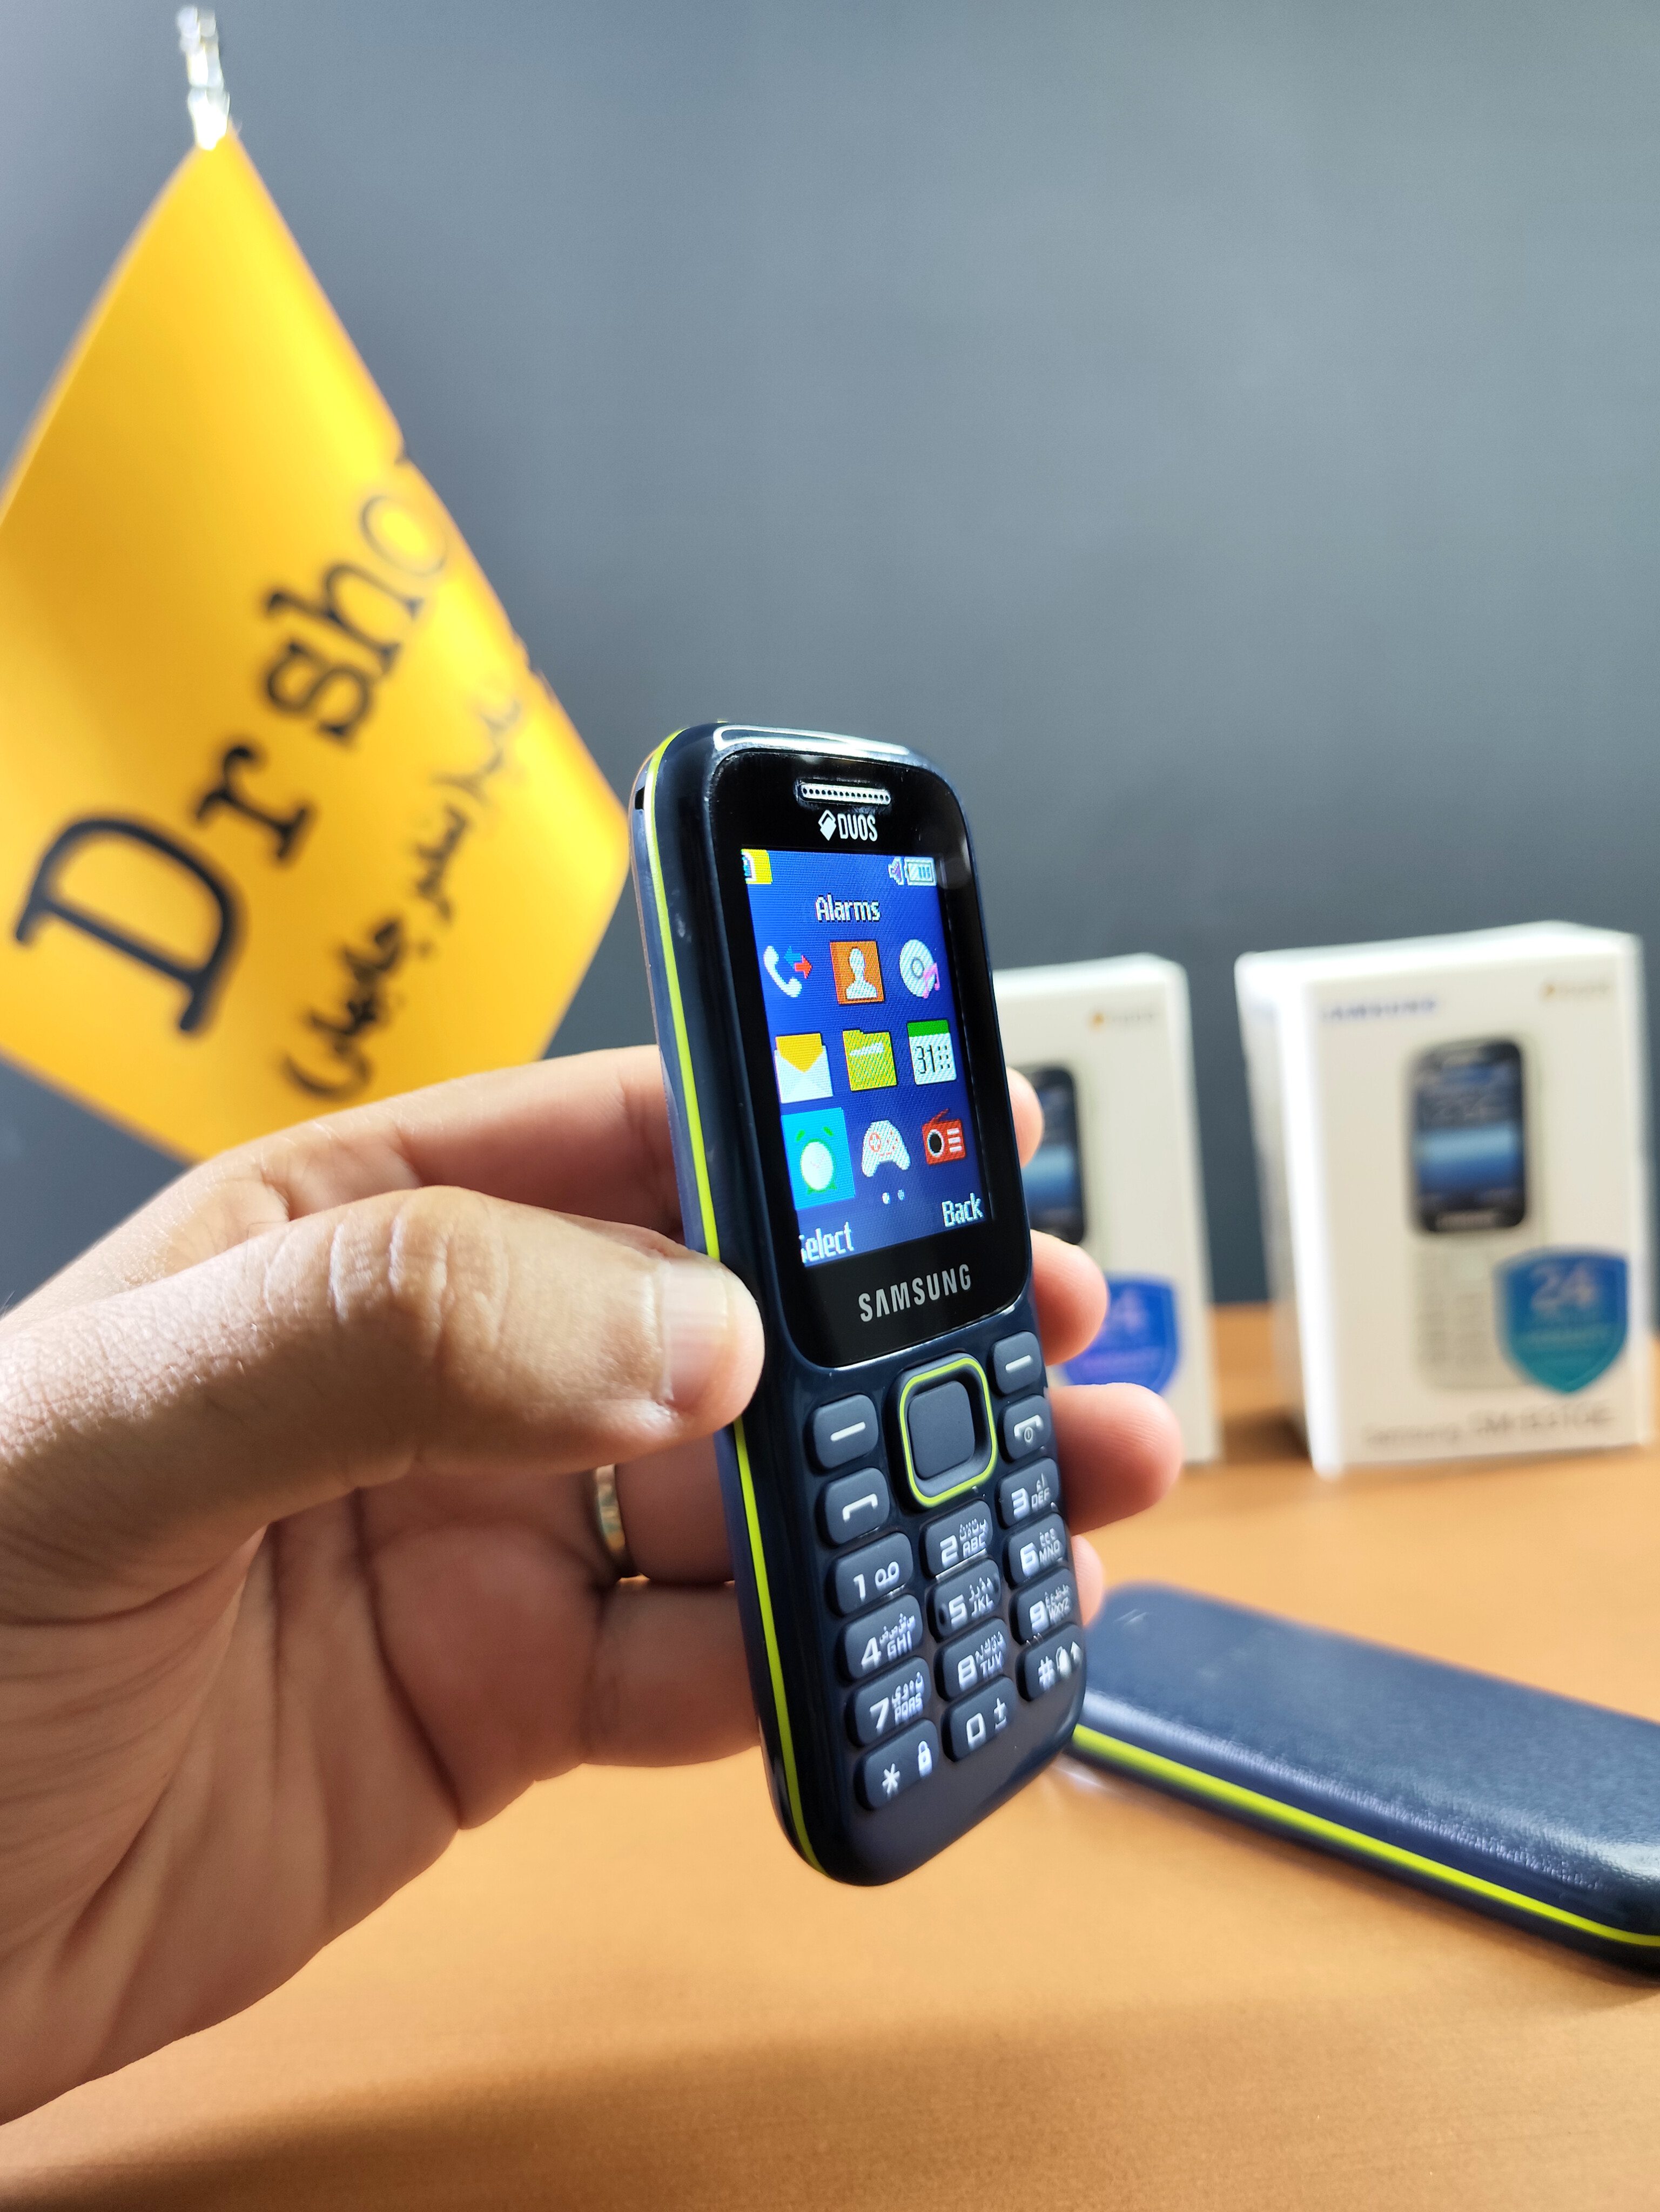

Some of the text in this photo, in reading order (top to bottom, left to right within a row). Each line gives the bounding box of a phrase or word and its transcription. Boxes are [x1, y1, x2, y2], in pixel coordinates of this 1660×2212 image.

[14, 459, 448, 1038] Dr sho
[838, 813, 878, 842] DUOS
[815, 893, 881, 921] Alarms
[915, 1044, 936, 1074] 31
[942, 1192, 984, 1228] Back
[858, 1264, 972, 1323] SAMSUNG
[1011, 1487, 1050, 1519] 3 DEF
[940, 1532, 986, 1567] 2 ABC
[1020, 1539, 1062, 1575] 6 MNO
[853, 1573, 866, 1601] 1
[949, 1593, 993, 1629] 5 JKL
[1030, 1597, 1071, 1634] 9 WXYZ
[861, 1630, 912, 1669] 4 GHI
[958, 1651, 1004, 1691] 8 TUV
[870, 1697, 889, 1735] 7
